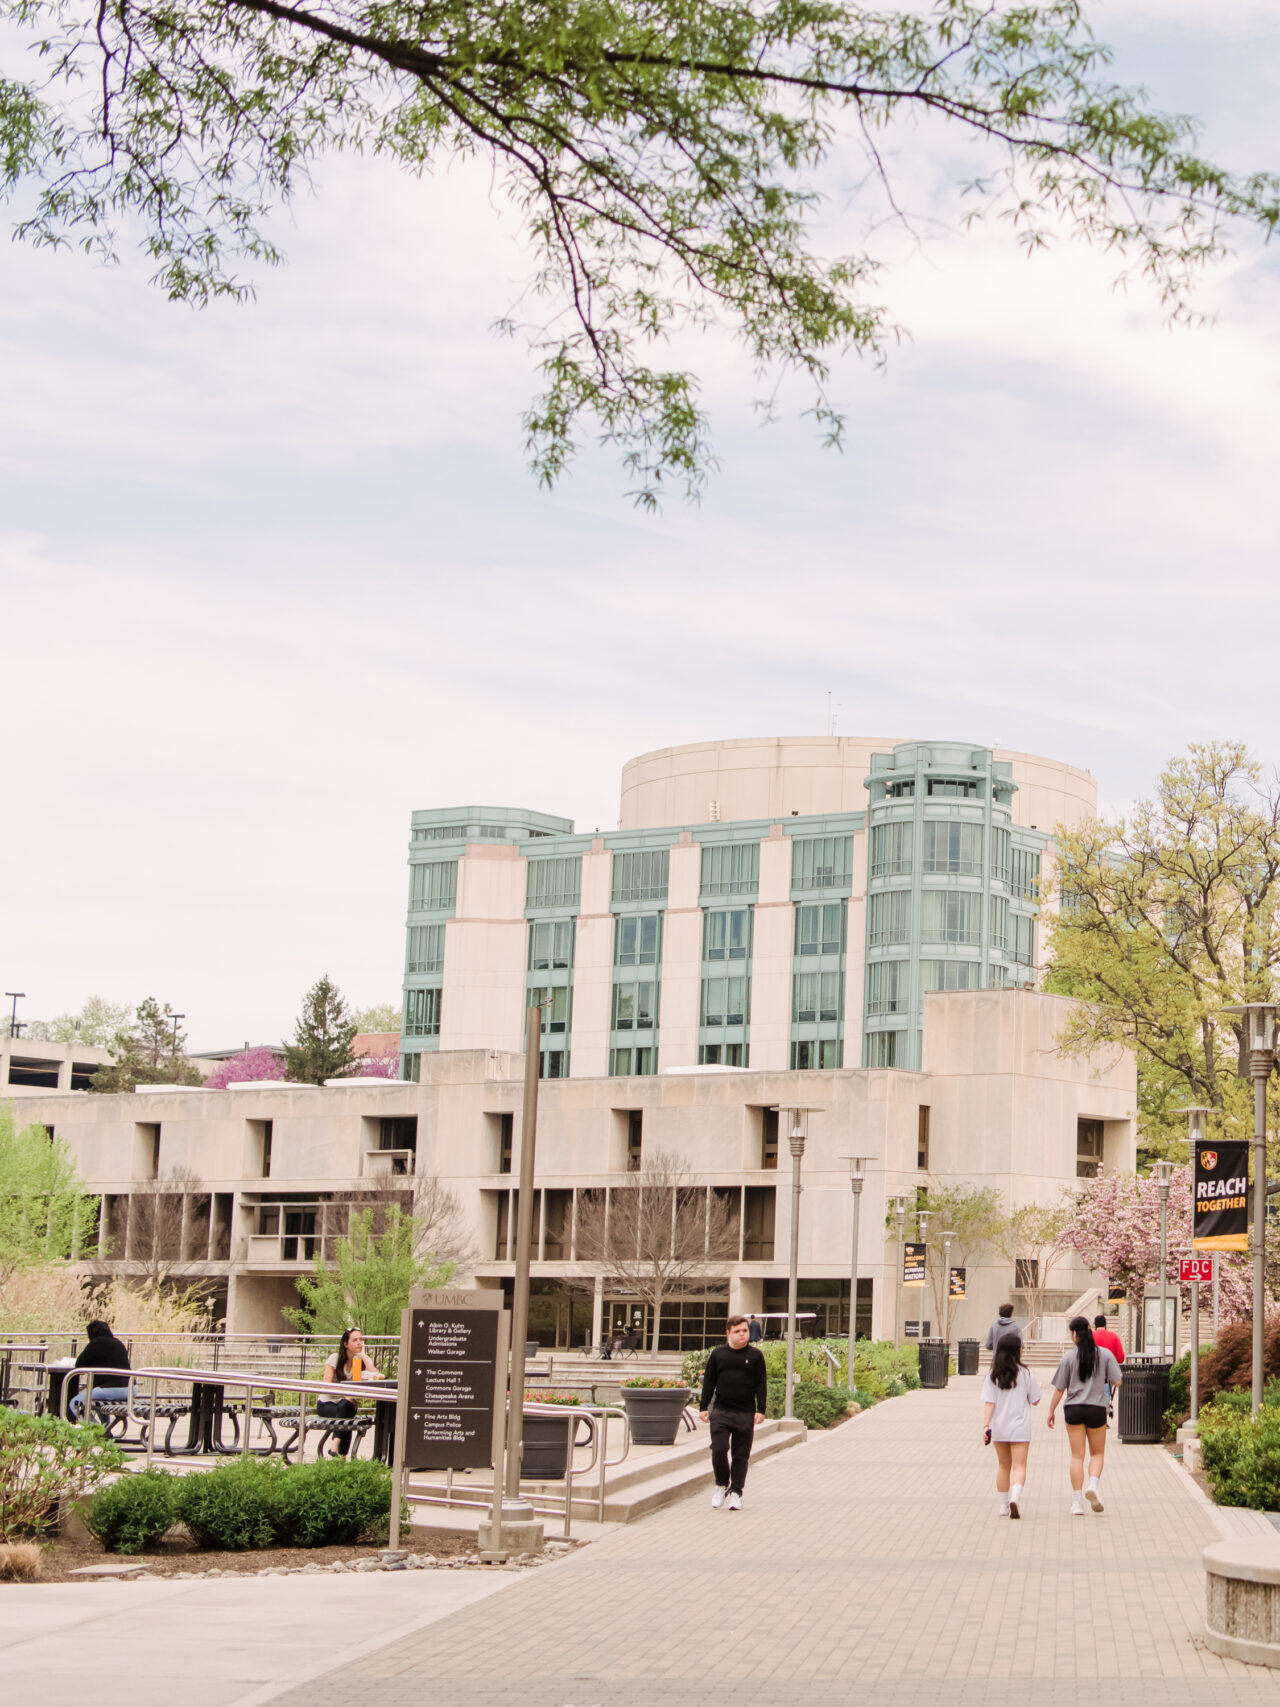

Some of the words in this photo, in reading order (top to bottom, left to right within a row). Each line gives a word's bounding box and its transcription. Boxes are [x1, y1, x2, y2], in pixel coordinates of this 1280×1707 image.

[1197, 1177, 1246, 1198] REACH
[1196, 1197, 1246, 1212] TOGETHER
[1182, 1261, 1209, 1273] FDC
[435, 1294, 472, 1305] UMBC
